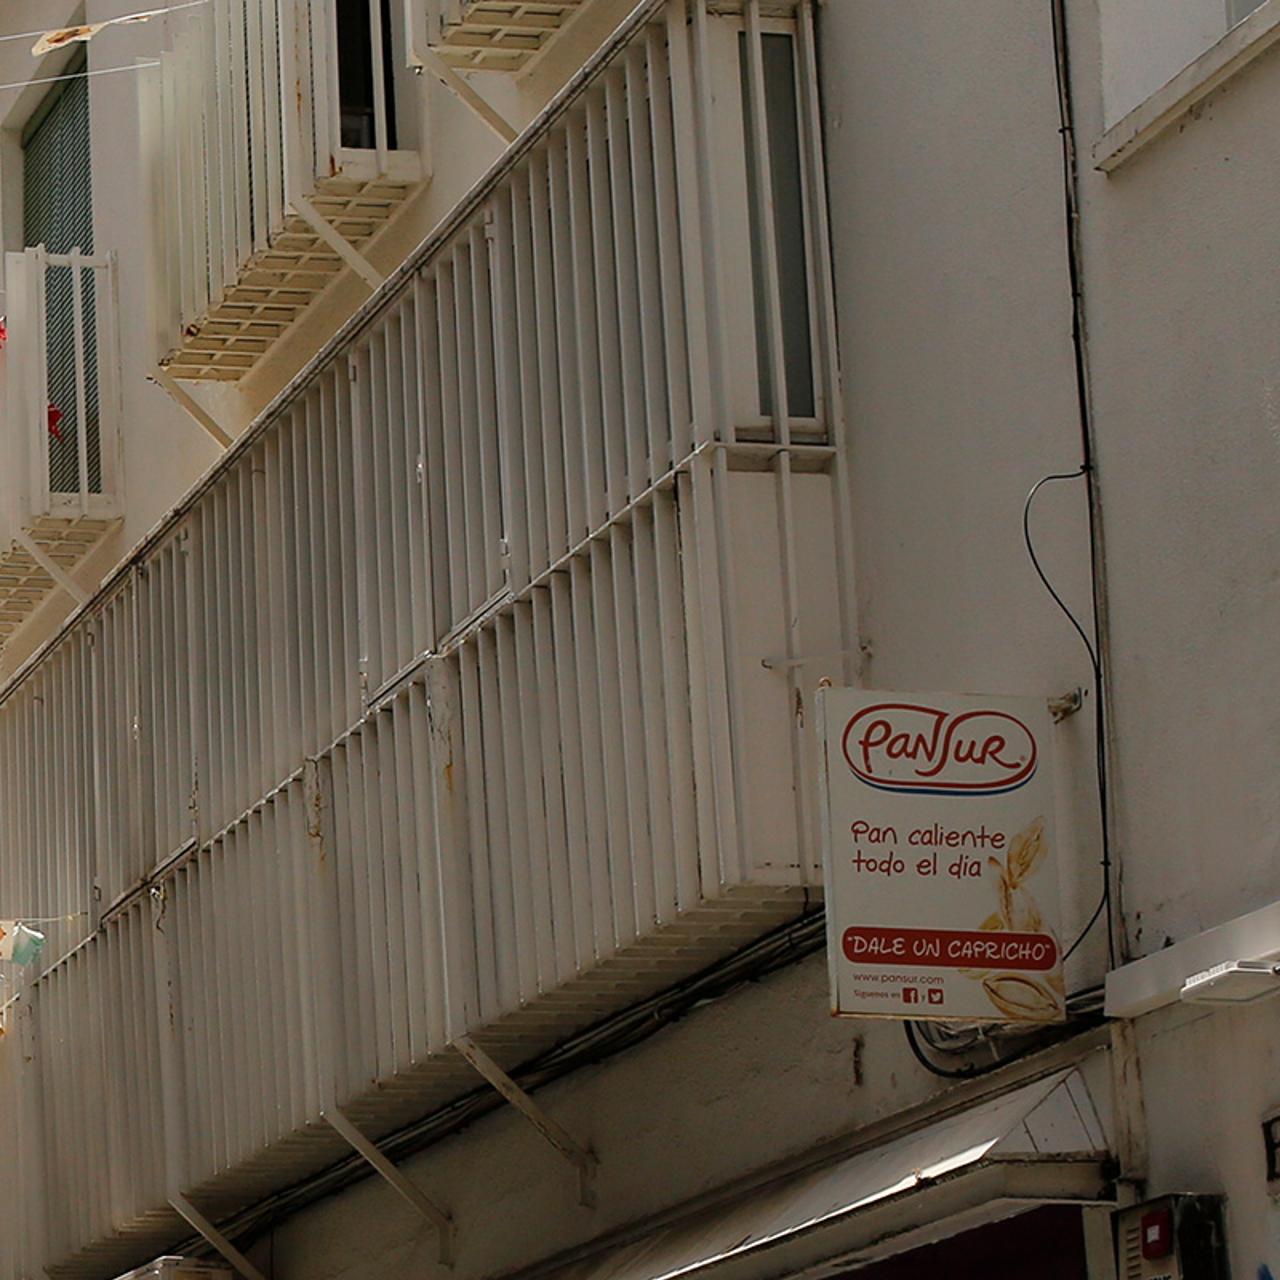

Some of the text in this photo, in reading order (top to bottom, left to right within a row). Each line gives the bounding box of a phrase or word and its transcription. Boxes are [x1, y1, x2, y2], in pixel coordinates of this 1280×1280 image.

[850, 820, 1006, 849] Pan caliente
[851, 849, 906, 876] todo
[916, 856, 938, 877] el
[912, 938, 942, 959] UN
